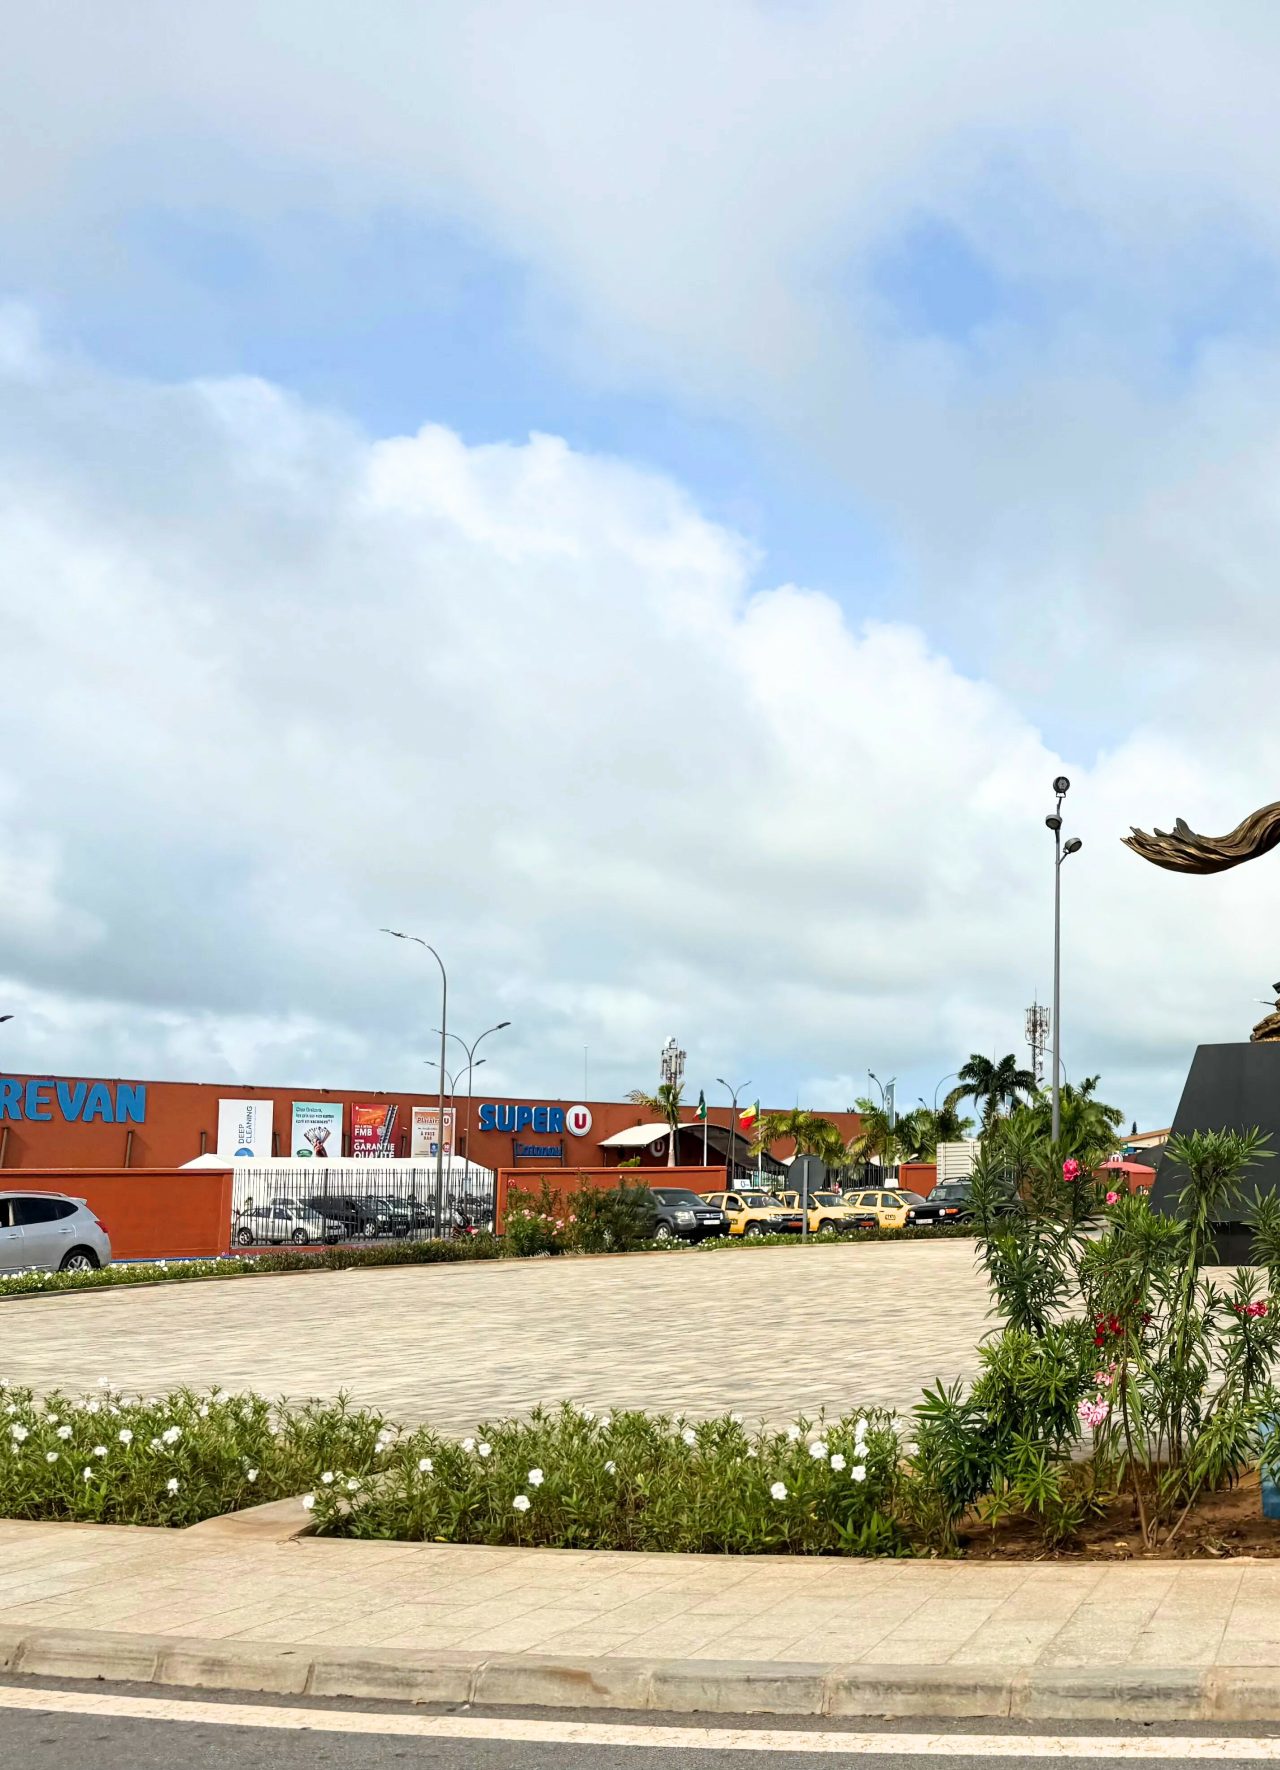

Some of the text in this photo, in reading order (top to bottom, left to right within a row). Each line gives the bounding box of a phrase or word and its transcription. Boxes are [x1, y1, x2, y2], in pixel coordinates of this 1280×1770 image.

[478, 1104, 587, 1133] SUPER U
[354, 1143, 395, 1151] GARANTIE
